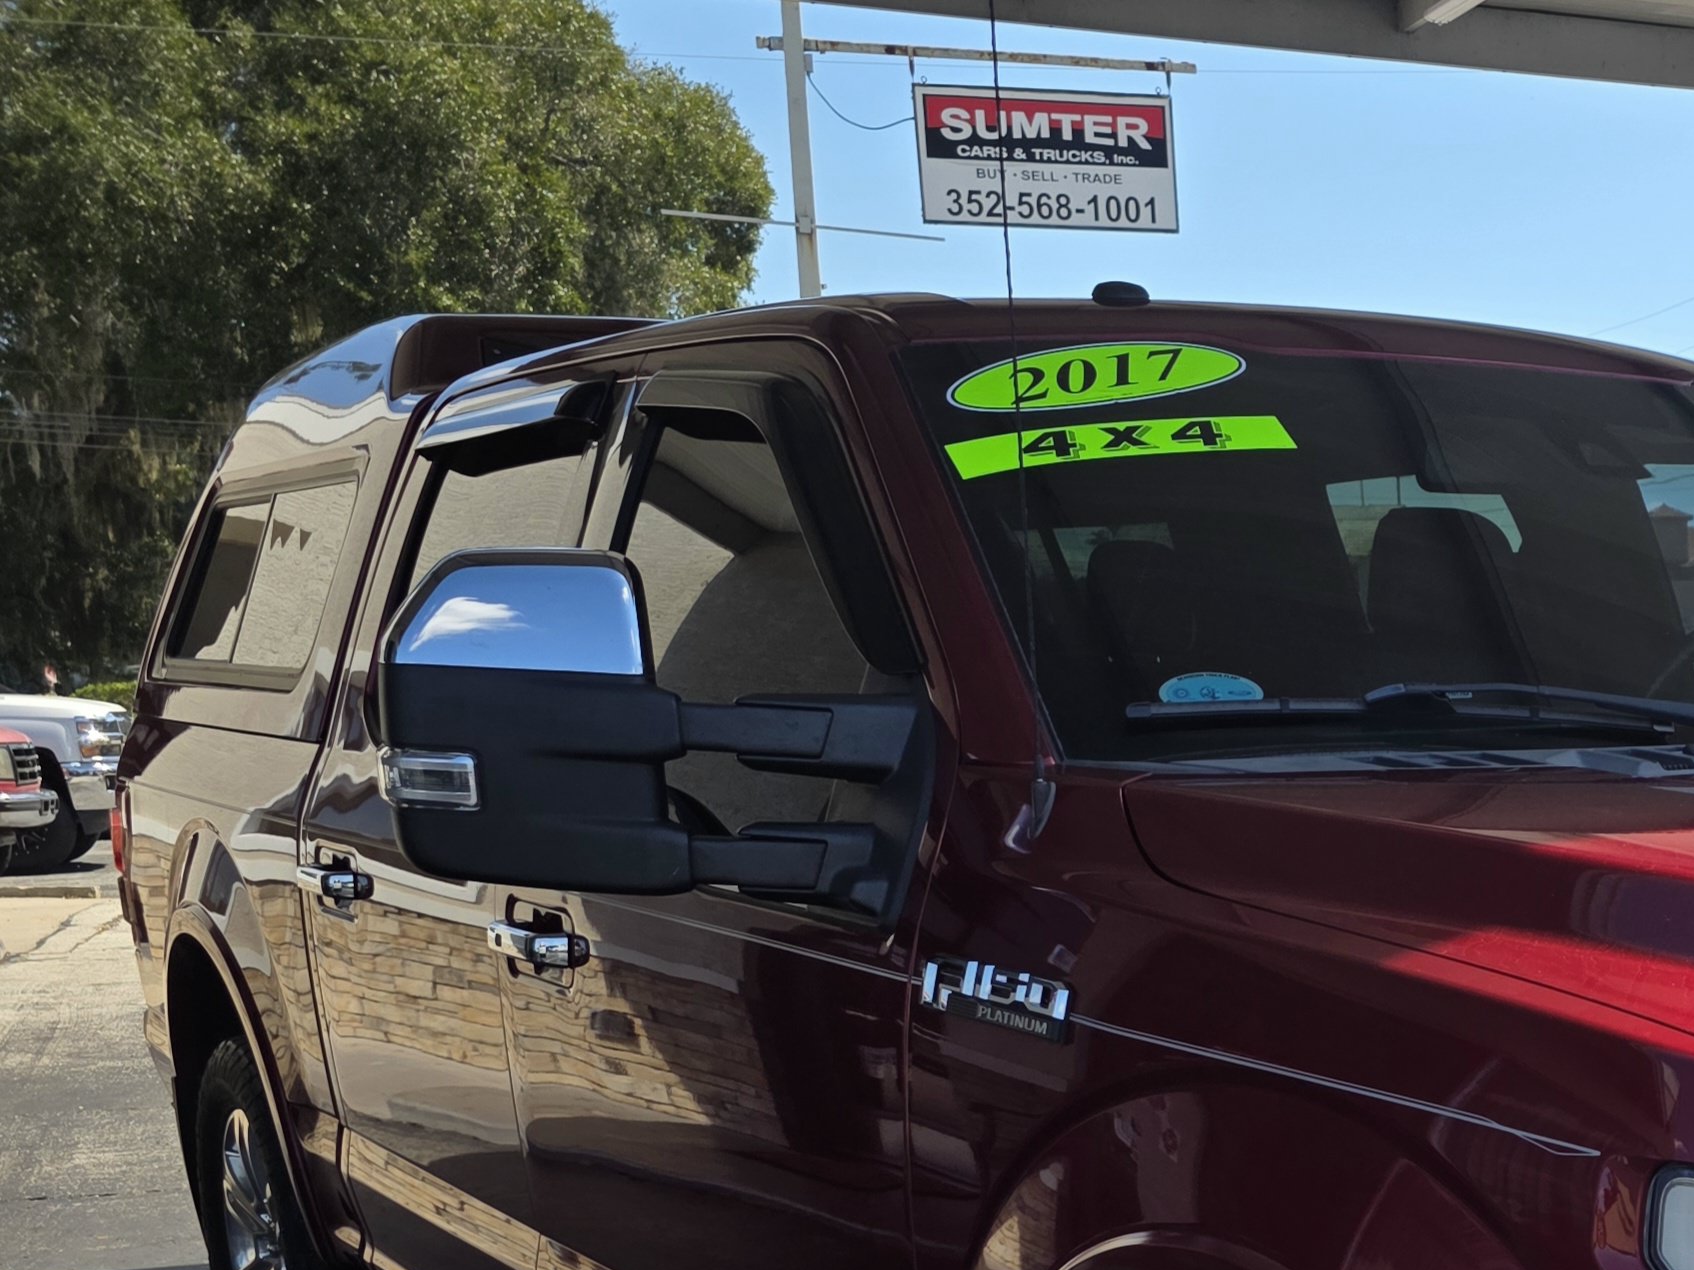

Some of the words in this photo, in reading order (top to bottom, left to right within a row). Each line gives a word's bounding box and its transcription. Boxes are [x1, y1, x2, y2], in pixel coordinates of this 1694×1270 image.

[940, 107, 1152, 150] SUMTER
[956, 145, 1008, 159] CARS
[1013, 147, 1027, 160] &
[1031, 148, 1110, 164] TRUCKS,
[1113, 154, 1139, 165] Inc.
[1021, 170, 1059, 182] SELL
[1072, 172, 1123, 185] TRADE
[946, 188, 1157, 224] 352-568-1001
[1009, 347, 1184, 406] 2017
[976, 1003, 1048, 1035] PLATINUM
